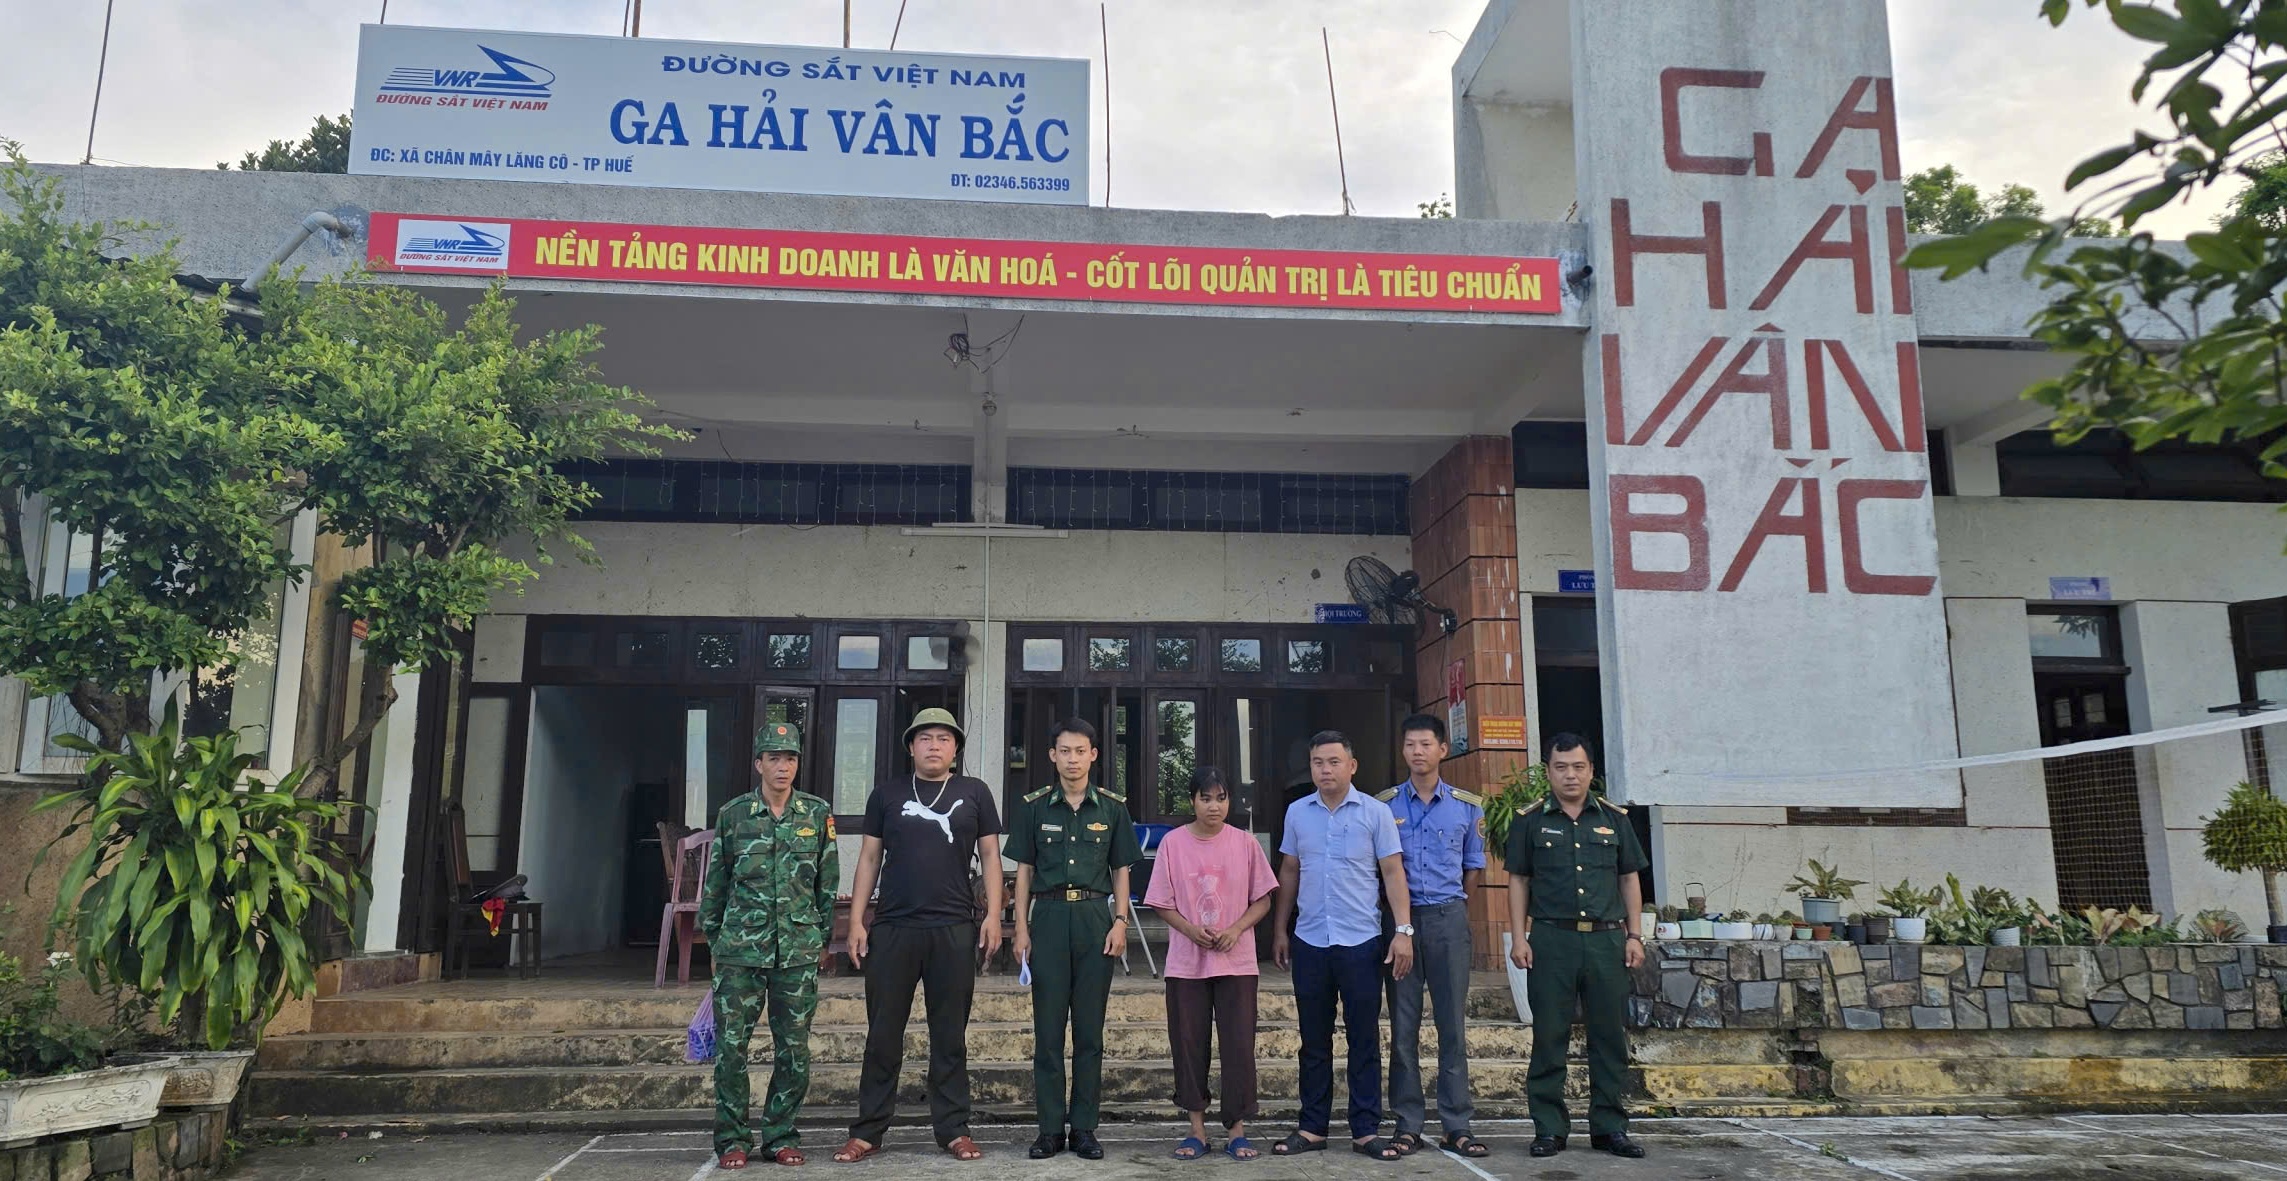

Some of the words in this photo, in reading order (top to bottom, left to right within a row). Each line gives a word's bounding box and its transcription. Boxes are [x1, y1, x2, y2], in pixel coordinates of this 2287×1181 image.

[433, 69, 480, 87] VNR
[661, 54, 791, 77] ĐƯỜNG
[802, 56, 861, 80] SẮT
[872, 63, 939, 88] VIỆT
[950, 69, 1026, 88] NAM
[376, 92, 432, 106] ĐƯỜNG
[472, 97, 507, 111] VIỆT
[509, 100, 549, 111] NAM
[609, 98, 690, 147] GA
[706, 88, 809, 152] HẢI
[827, 98, 941, 158] VÂN
[960, 92, 1070, 163] BẮC
[1660, 66, 1901, 182] GA
[370, 147, 395, 163] ĐC:
[399, 146, 420, 164] XÃ
[424, 148, 465, 166] CHÂN
[469, 150, 502, 167] MÂY
[506, 151, 544, 169] LĂNG
[548, 153, 569, 170] CÔ
[583, 157, 600, 171] TP
[604, 154, 634, 173] HUẾ
[951, 173, 971, 188] ĐT:
[975, 174, 1070, 192] 02346.563399
[433, 238, 461, 250] VNR
[535, 228, 600, 267] NỀN
[608, 231, 688, 271] TẢNG
[697, 243, 770, 274] KINH
[779, 247, 880, 279] DOANH
[889, 246, 924, 281] LÀ
[932, 249, 991, 284] VĂN
[1000, 252, 1058, 286] HOÁ
[1086, 250, 1140, 289] CỐT
[1148, 257, 1191, 291] LÕI
[1200, 256, 1277, 295] QUẢN
[1285, 266, 1328, 301] TRỊ
[1337, 262, 1371, 297] LÀ
[1378, 264, 1438, 298] TIÊU
[1447, 262, 1542, 301] CHUẨN
[1610, 169, 1913, 315] HẢI
[1601, 321, 1926, 453] VÂN
[1608, 456, 1938, 596] BẮC
